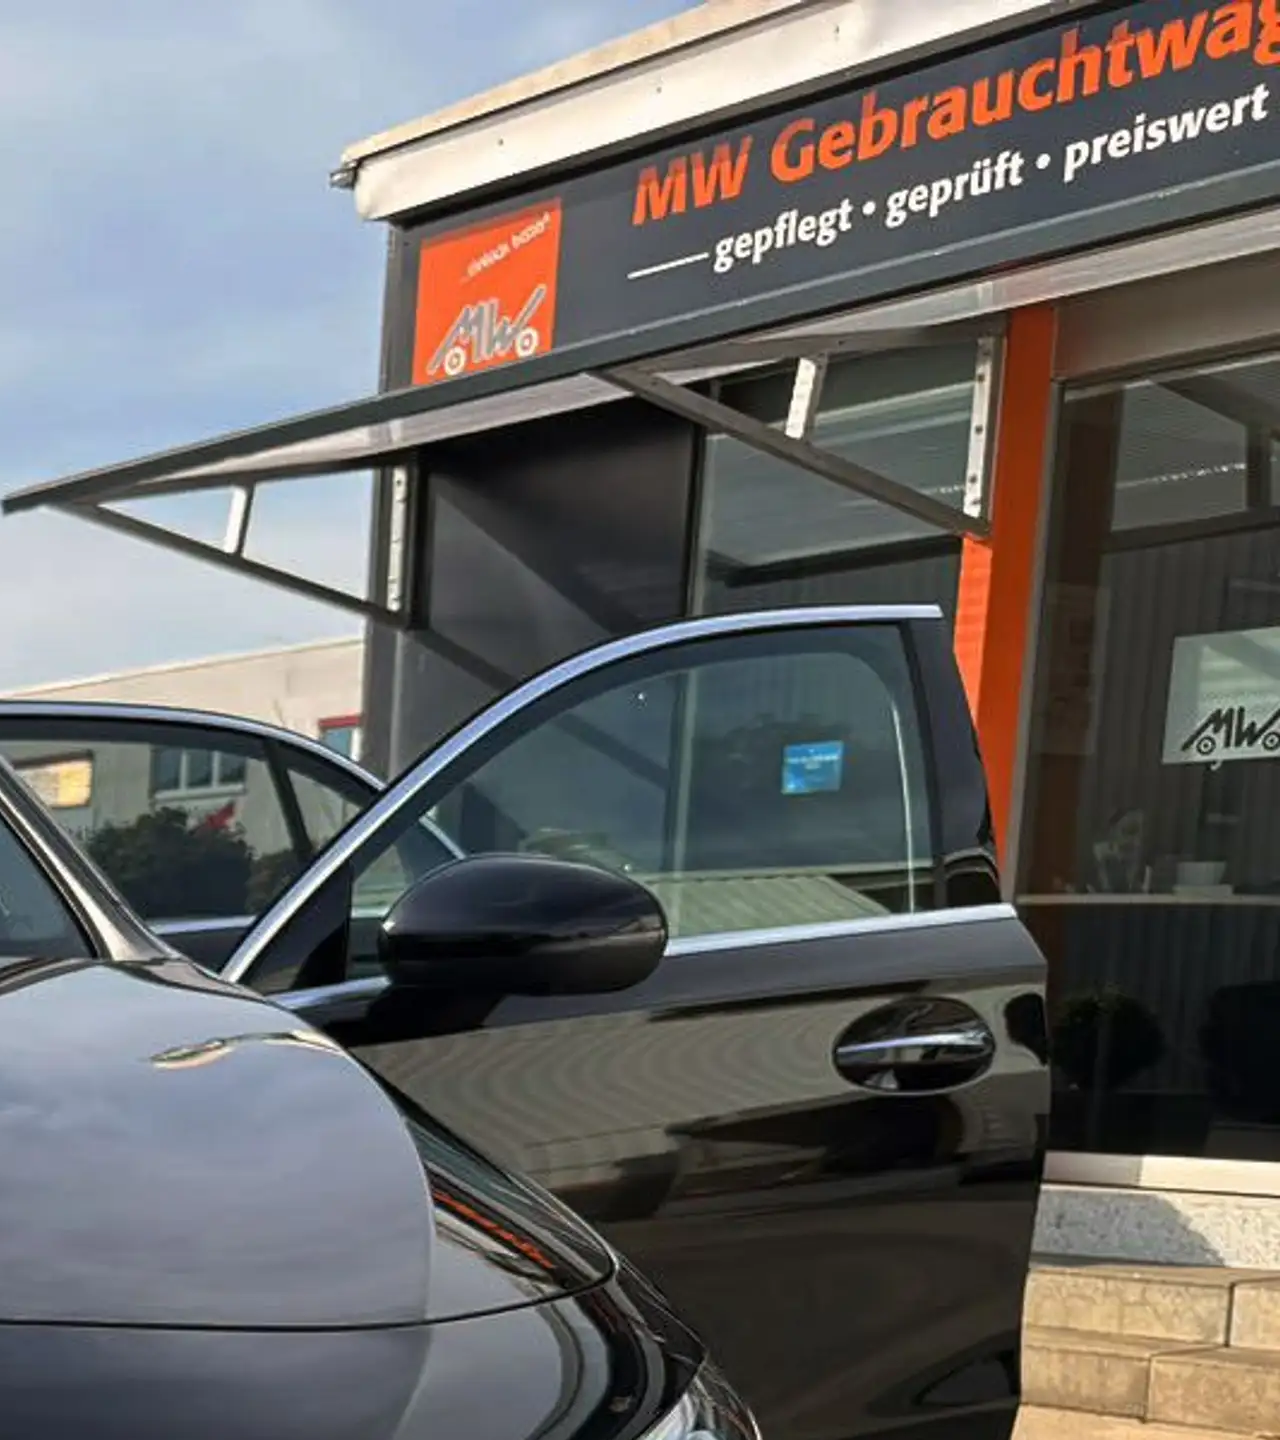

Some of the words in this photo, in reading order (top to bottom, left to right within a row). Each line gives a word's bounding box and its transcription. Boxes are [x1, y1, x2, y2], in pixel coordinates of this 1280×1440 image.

[632, 134, 753, 225] MW
[713, 198, 853, 273] gepflegt
[885, 150, 1025, 228] geprüft
[1063, 83, 1270, 183] preiswert
